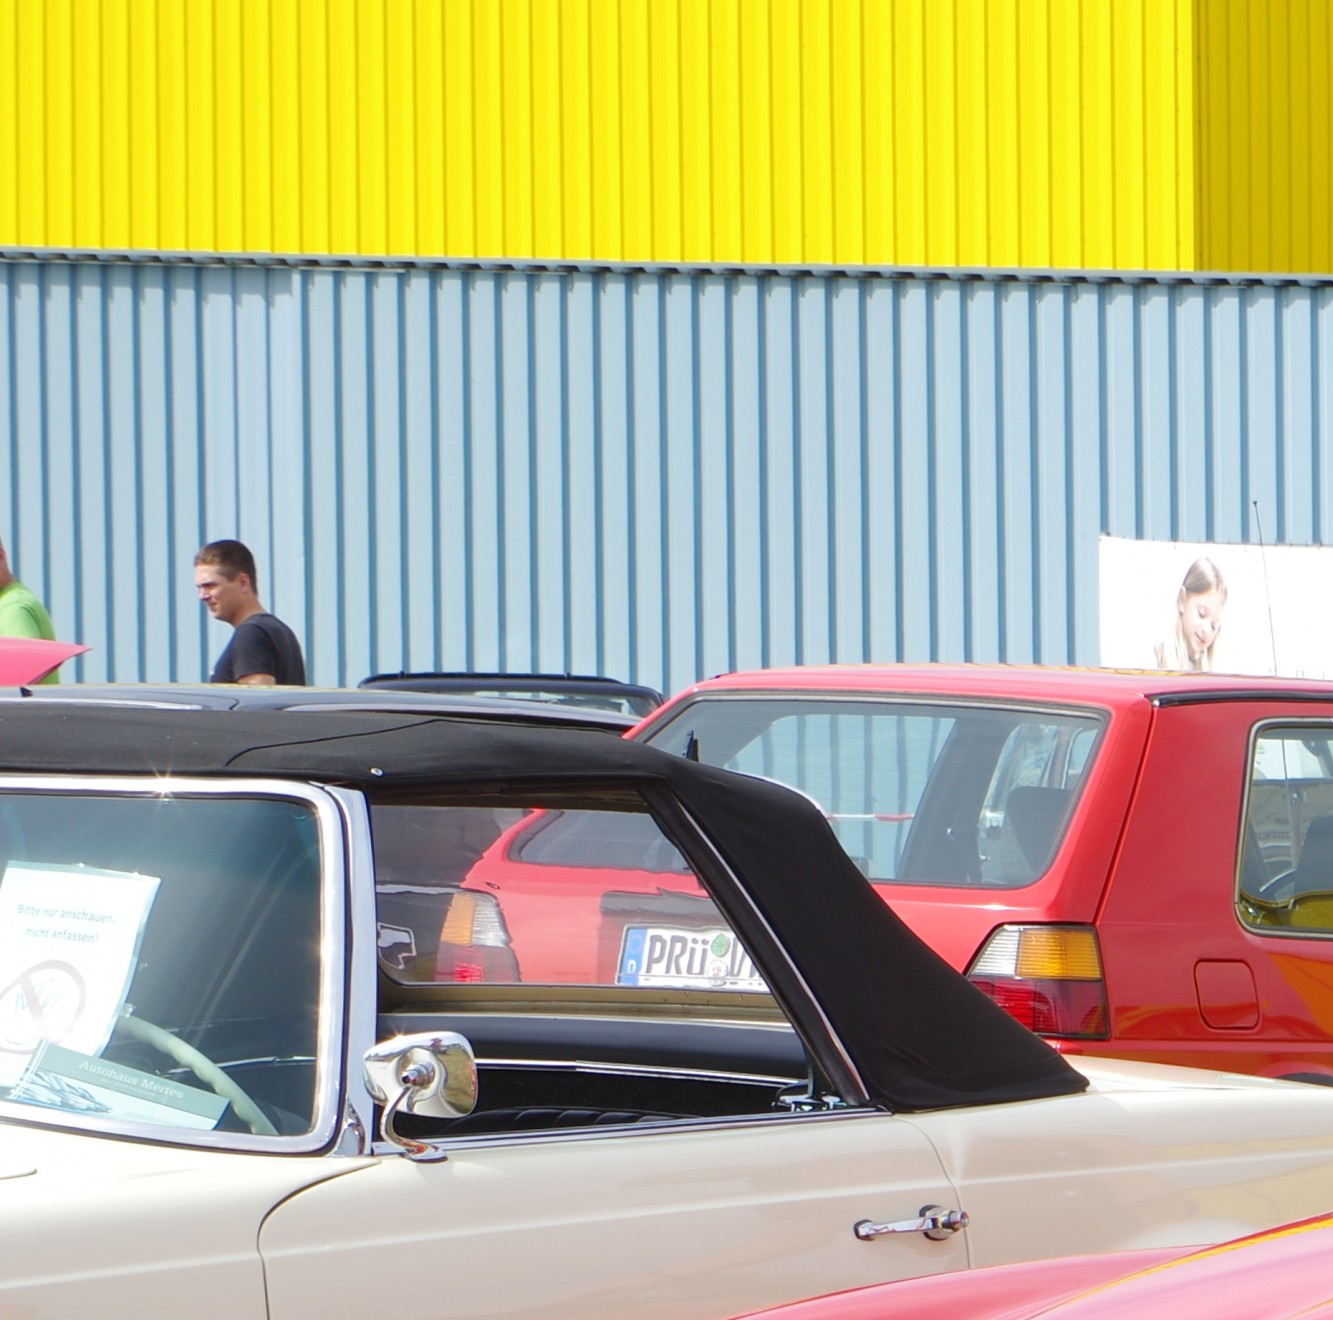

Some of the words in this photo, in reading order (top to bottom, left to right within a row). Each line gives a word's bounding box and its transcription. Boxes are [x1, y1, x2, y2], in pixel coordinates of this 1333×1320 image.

[17, 903, 41, 917] Bitte
[43, 908, 58, 918] nur
[25, 927, 49, 939] nicht
[78, 1060, 139, 1086] Autohaus
[140, 1078, 185, 1100] Mertes
